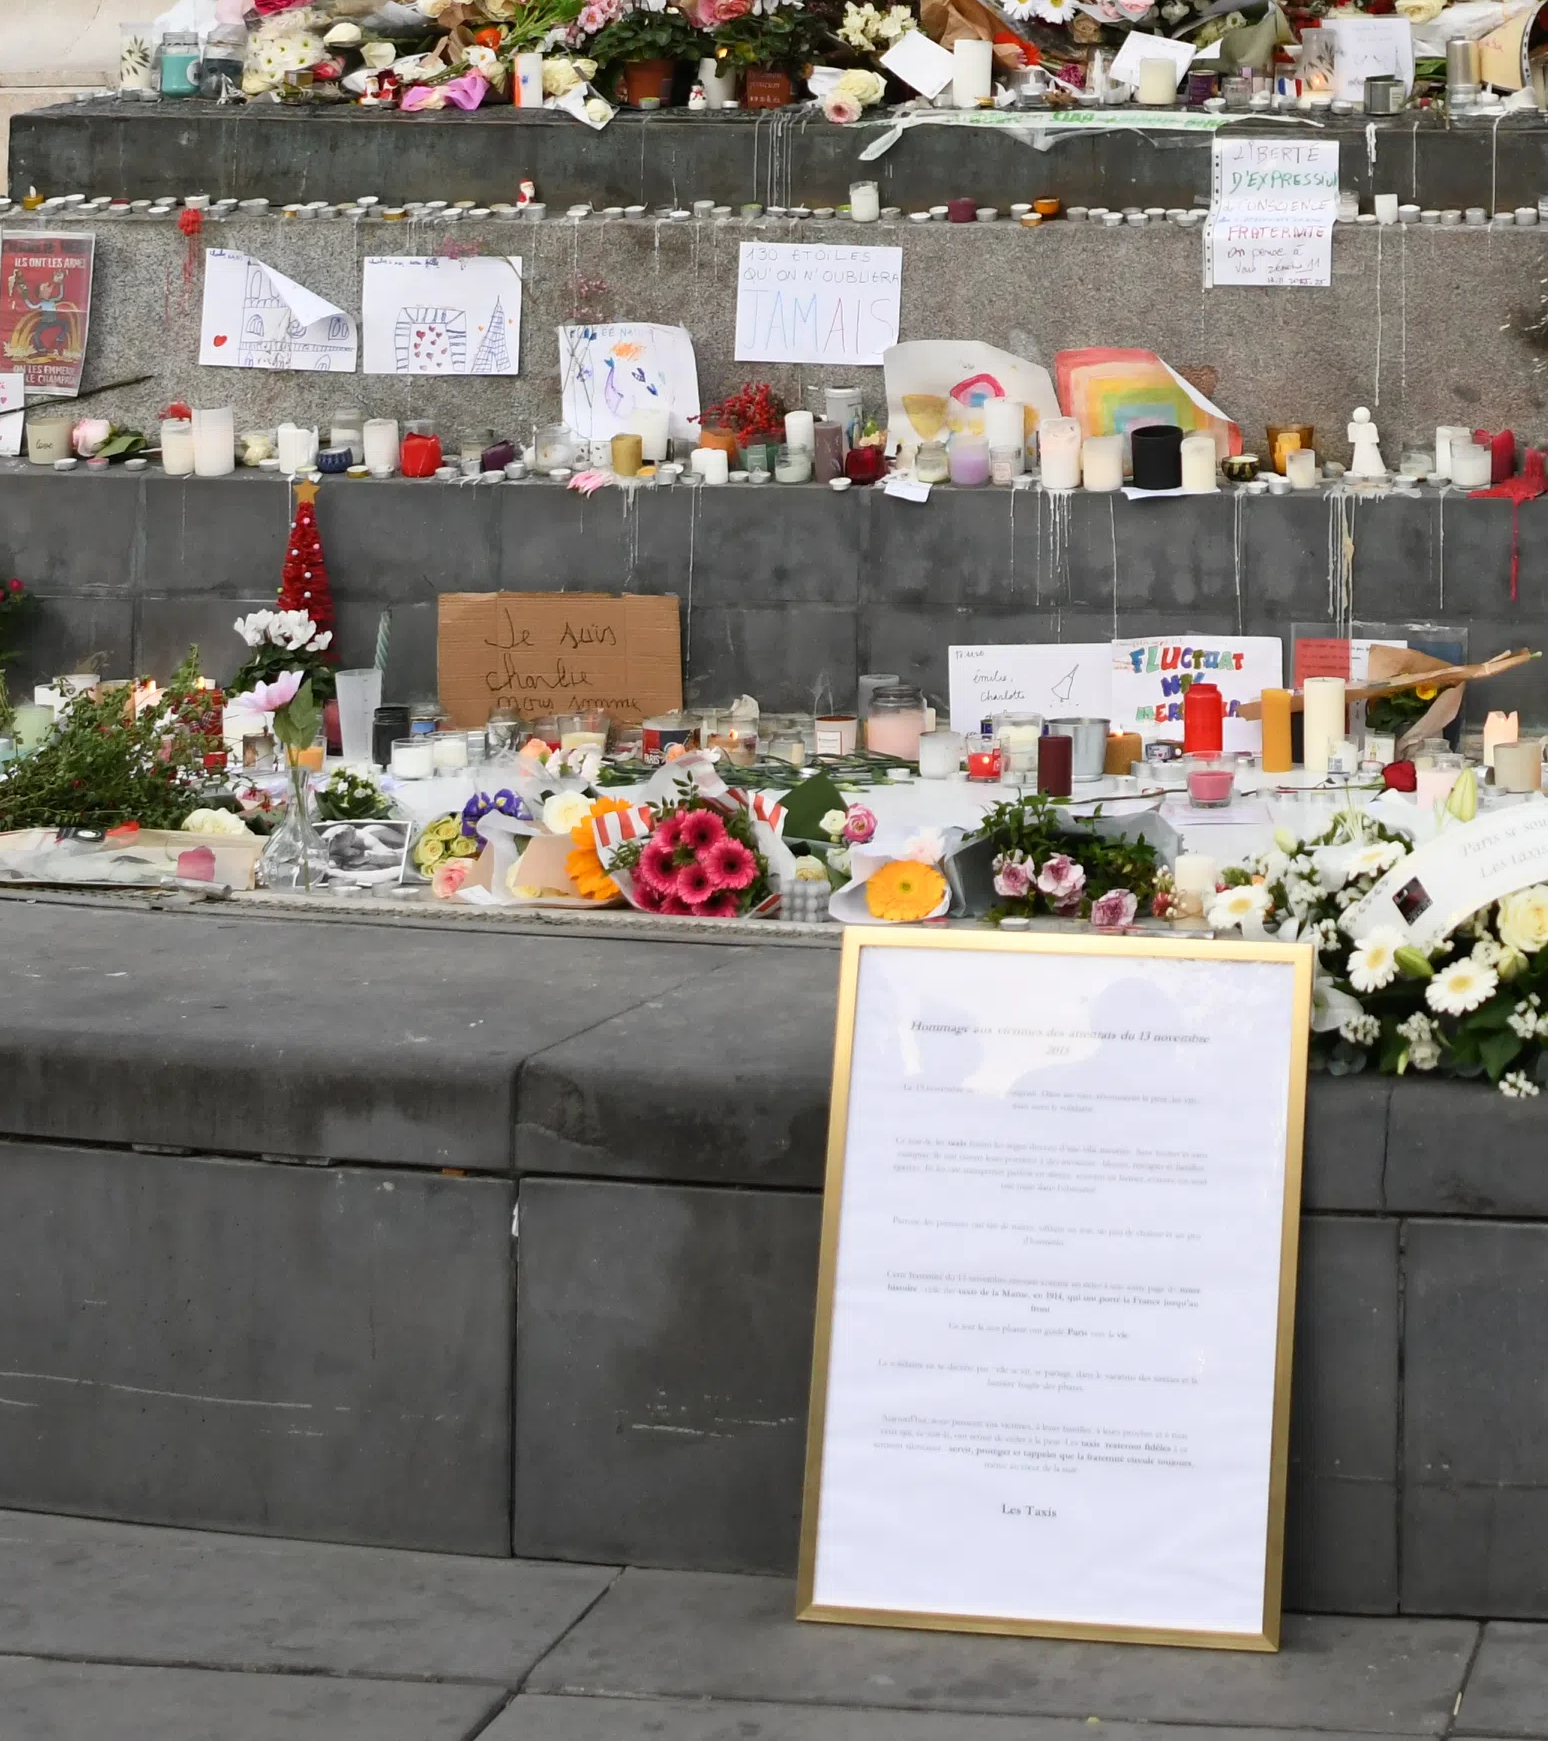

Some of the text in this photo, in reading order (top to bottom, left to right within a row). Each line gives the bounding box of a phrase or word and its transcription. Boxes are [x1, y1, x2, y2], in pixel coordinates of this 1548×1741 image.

[29, 258, 45, 268] ONT
[47, 258, 62, 268] LES
[746, 248, 778, 261] 130
[740, 289, 894, 355] JAMAIS
[484, 608, 535, 649] Je
[1131, 646, 1245, 673] FLUCTUAT
[1001, 1503, 1057, 1518] Les Taxis
